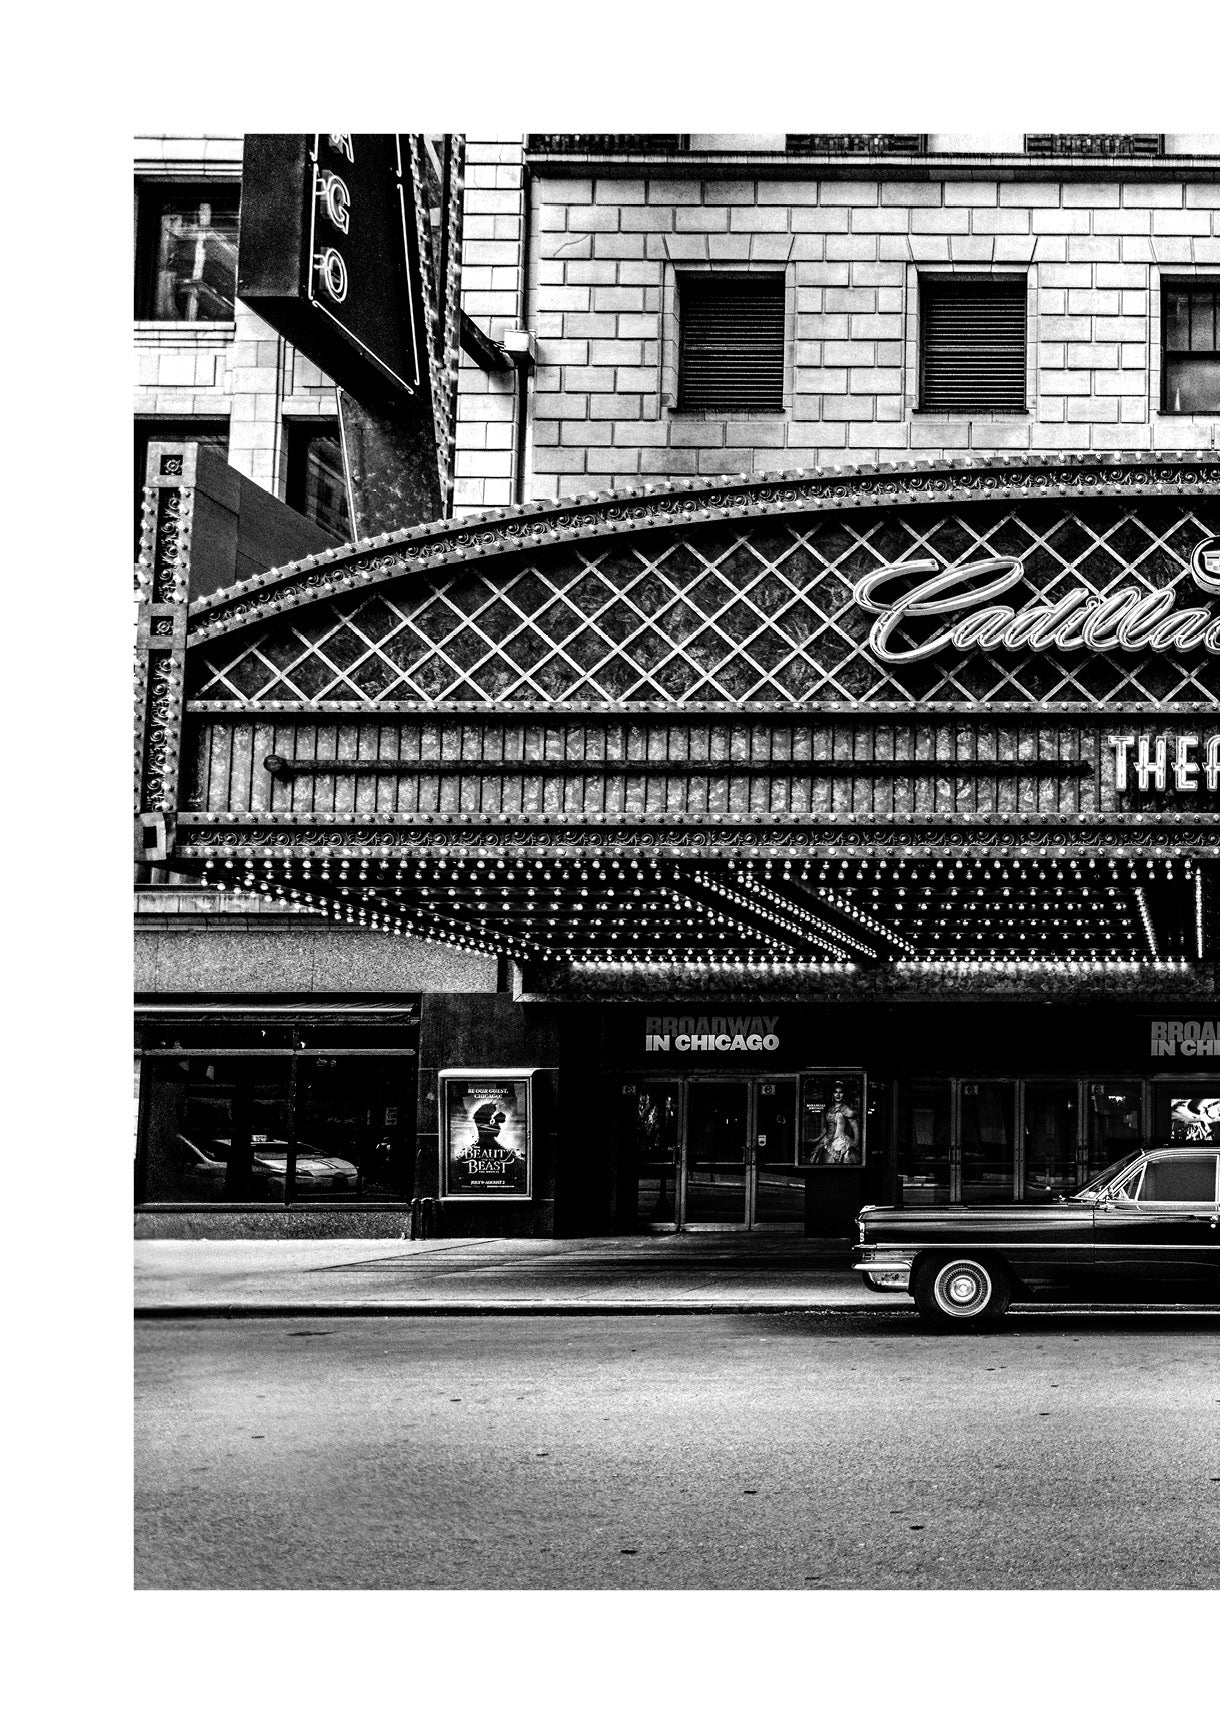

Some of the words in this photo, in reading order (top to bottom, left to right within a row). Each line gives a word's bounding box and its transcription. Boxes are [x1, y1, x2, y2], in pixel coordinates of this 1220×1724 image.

[646, 1016, 779, 1037] BROADWAY
[646, 1034, 670, 1051] IN
[675, 1034, 780, 1051] CHICAGO
[1151, 1039, 1176, 1056] IN
[463, 1145, 515, 1162] BEAUTY
[461, 1158, 516, 1174] BEAST
